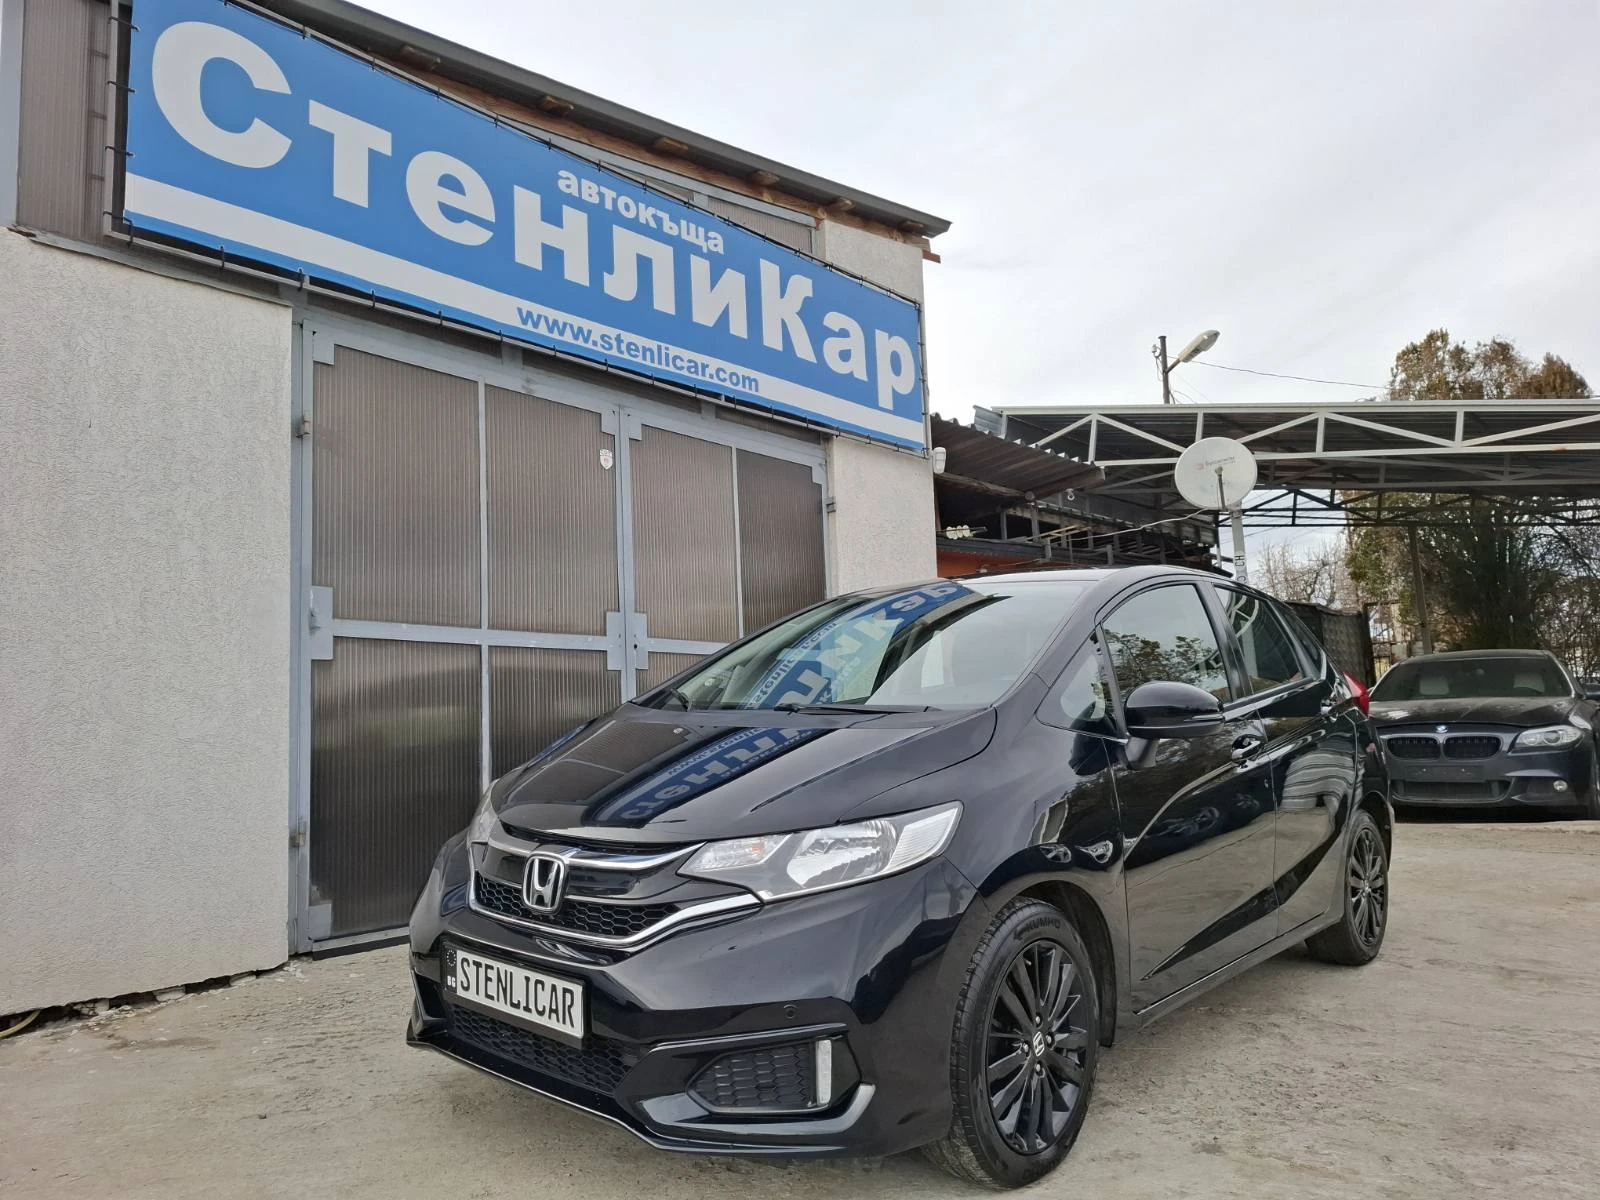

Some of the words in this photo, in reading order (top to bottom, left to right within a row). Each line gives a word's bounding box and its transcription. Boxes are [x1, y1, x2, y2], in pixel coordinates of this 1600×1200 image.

[152, 21, 916, 410] СтенлиКар
[557, 170, 725, 255] автокъща
[516, 307, 760, 393] www.stenlicar.com
[447, 975, 456, 988] BG
[460, 957, 575, 1029] STENLICAR
